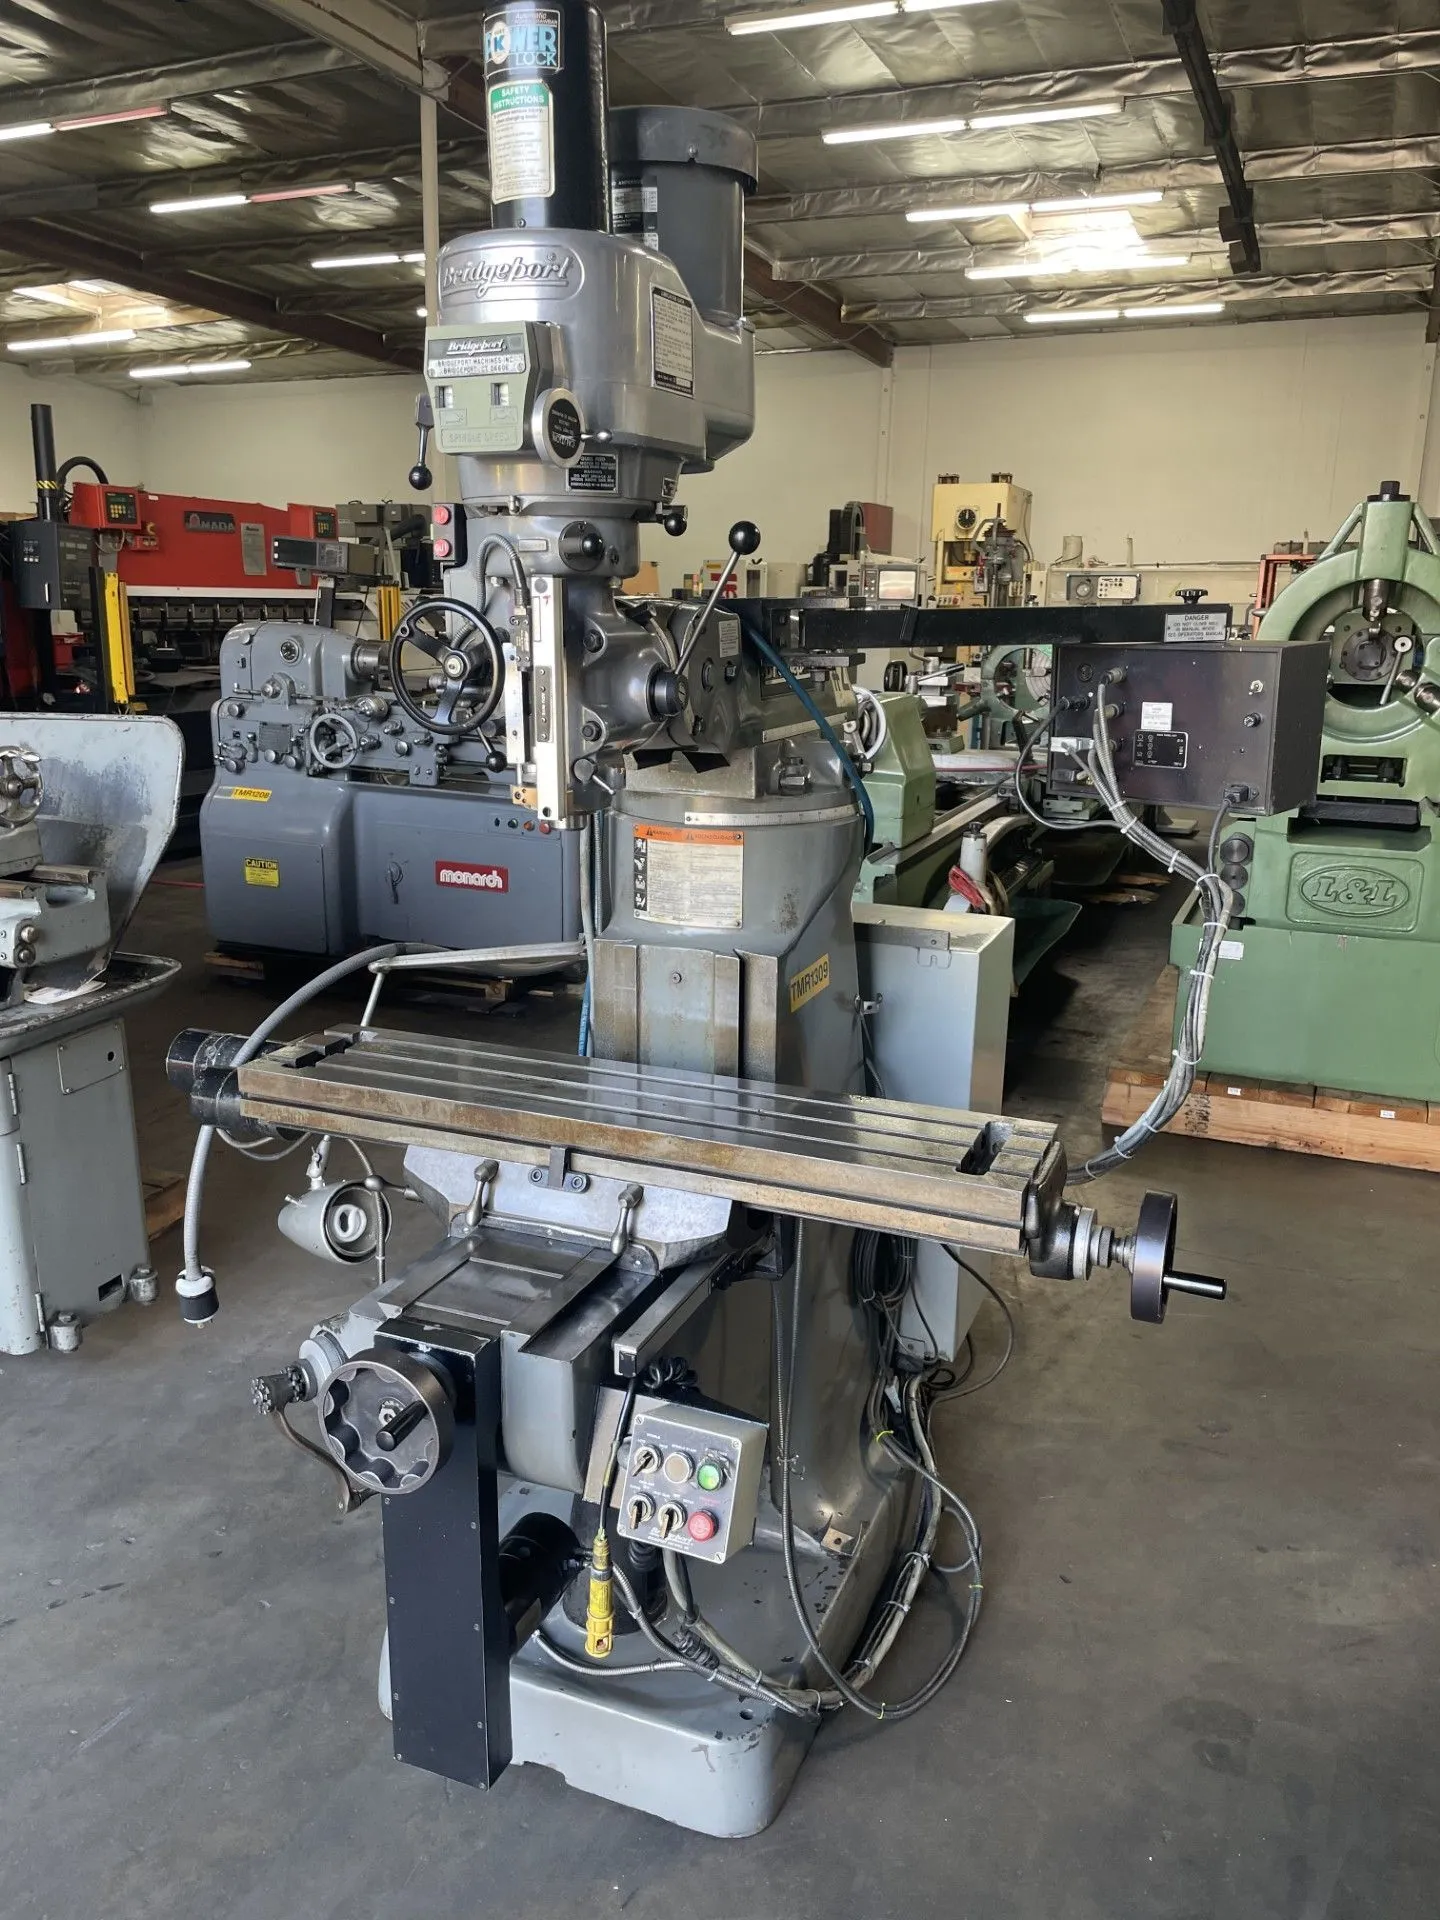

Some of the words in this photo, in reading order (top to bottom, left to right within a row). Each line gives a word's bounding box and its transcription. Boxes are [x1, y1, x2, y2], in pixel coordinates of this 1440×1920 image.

[516, 52, 557, 66] LOCK
[502, 85, 529, 97] SAFETY
[493, 95, 545, 110] INSTRUCTIONS
[443, 257, 573, 299] Bridgeport
[447, 339, 504, 356] Bridgeport
[246, 859, 277, 869] CAUTION
[440, 869, 503, 888] monarch
[1311, 876, 1397, 907] L&L
[791, 961, 828, 1001] TMR1309
